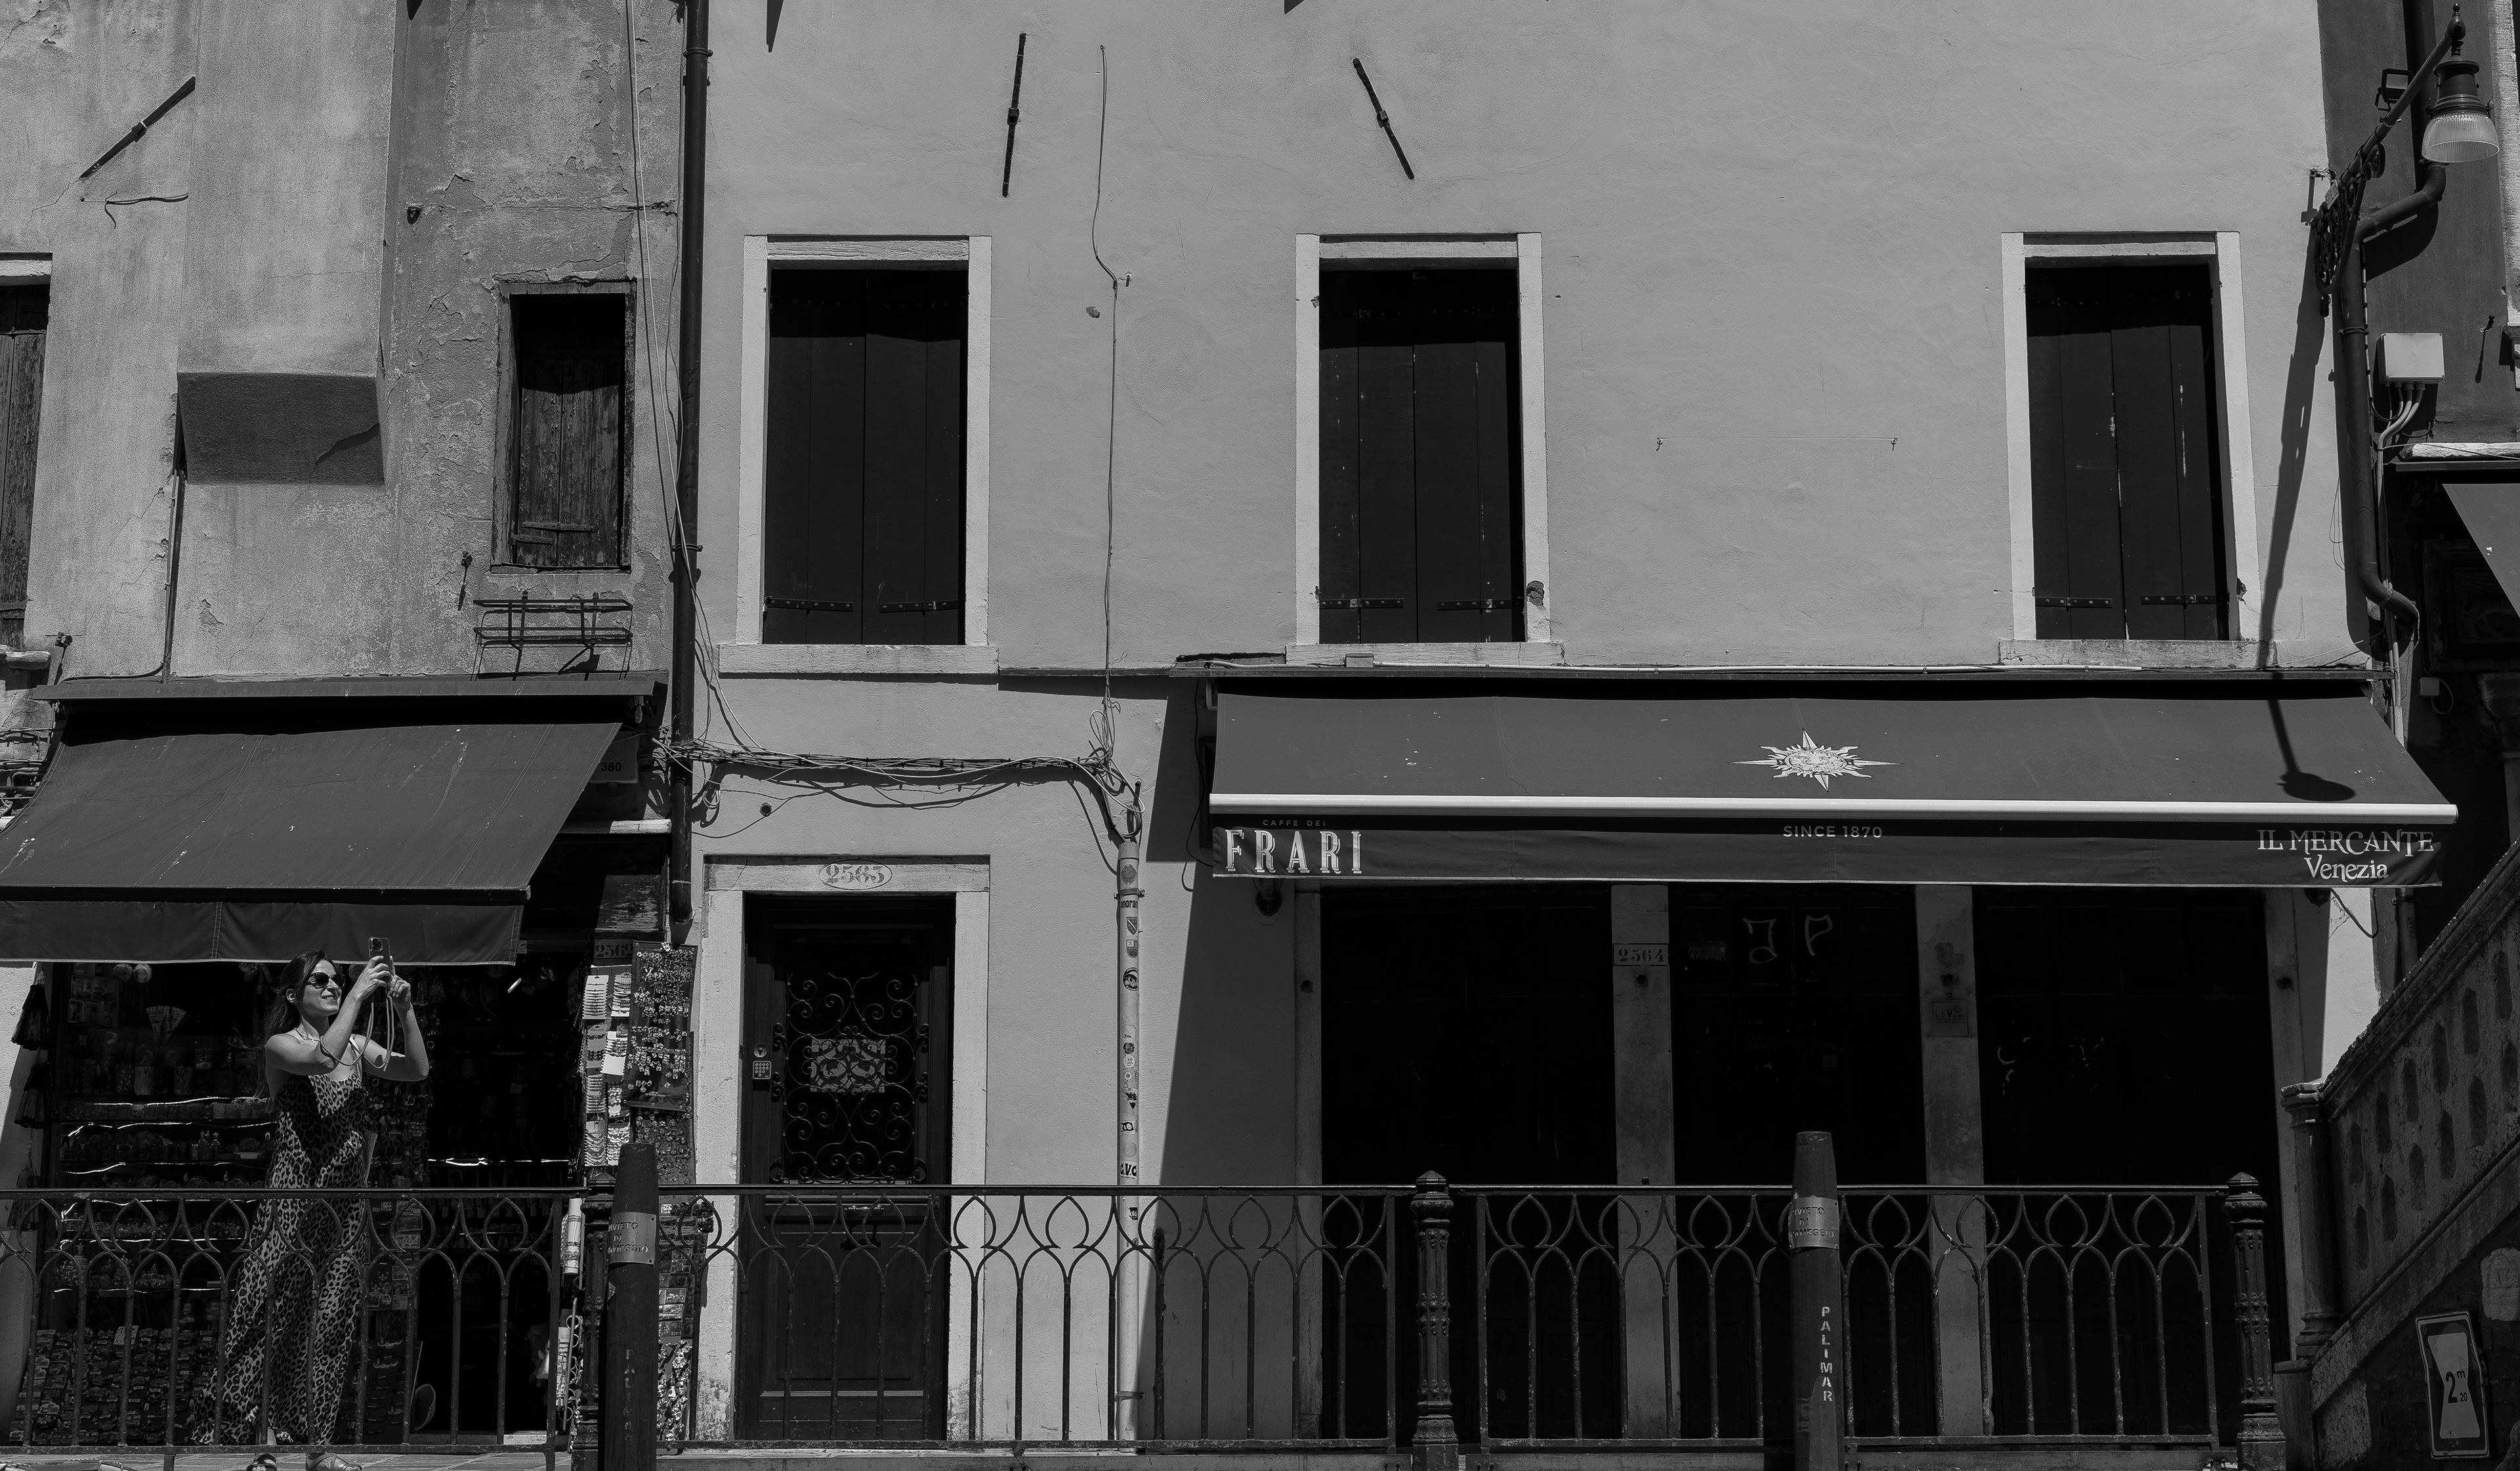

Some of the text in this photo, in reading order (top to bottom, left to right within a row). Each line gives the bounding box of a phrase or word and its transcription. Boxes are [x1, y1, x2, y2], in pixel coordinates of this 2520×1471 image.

[601, 762, 621, 771] 380
[1783, 825, 1883, 838] SINCE 1870
[2257, 828, 2435, 857] IL MERCANTE
[1225, 829, 1362, 874] FRARI
[826, 865, 885, 884] 2563
[2303, 854, 2389, 882] Venezia
[1618, 949, 1665, 962] 2564
[1820, 1306, 1833, 1401] PALIMAR
